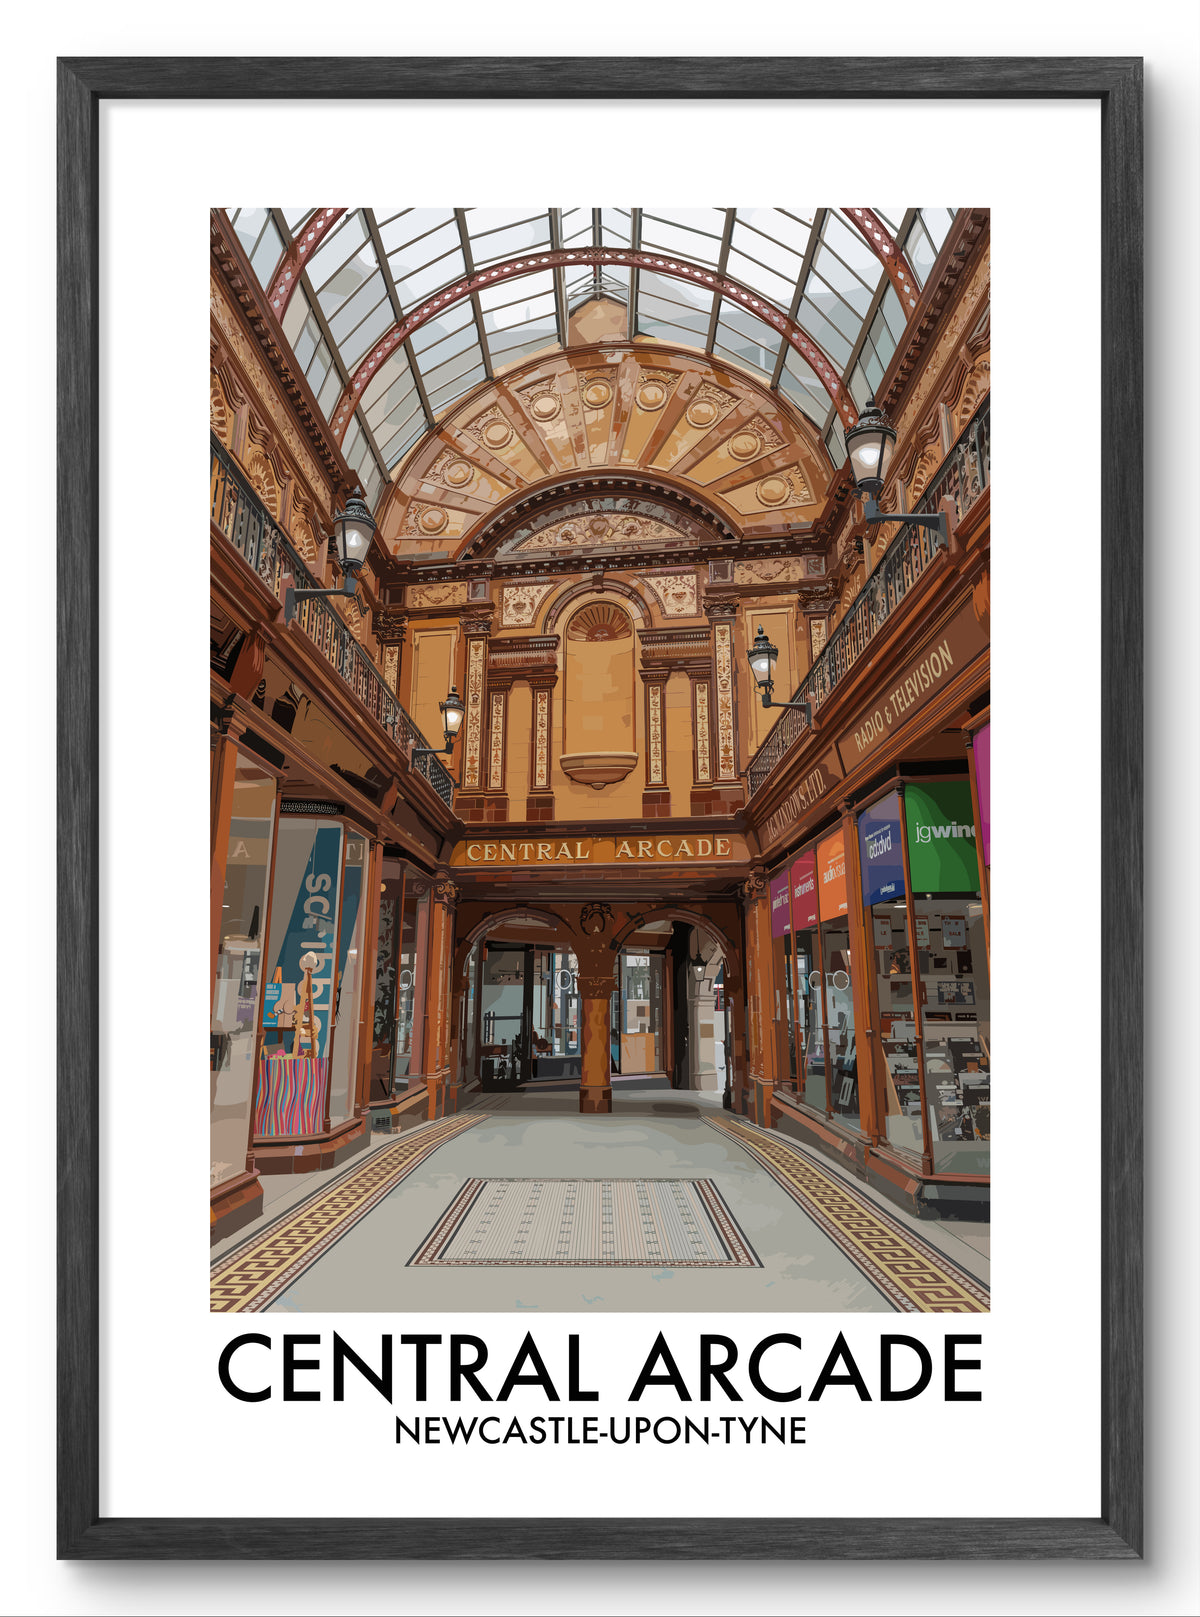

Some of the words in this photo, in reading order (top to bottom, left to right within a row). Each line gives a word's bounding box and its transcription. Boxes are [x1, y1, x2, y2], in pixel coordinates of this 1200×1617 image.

[854, 710, 884, 752] RADIO
[884, 706, 893, 725] &
[889, 640, 954, 717] TELEVISION
[466, 841, 591, 862] CENTRAL
[615, 838, 732, 859] ARCADE
[218, 1331, 599, 1404] CENTRAL
[628, 1331, 982, 1404] ARCADE
[396, 1416, 806, 1445] NEWCASTLE-UPON-TYNE
